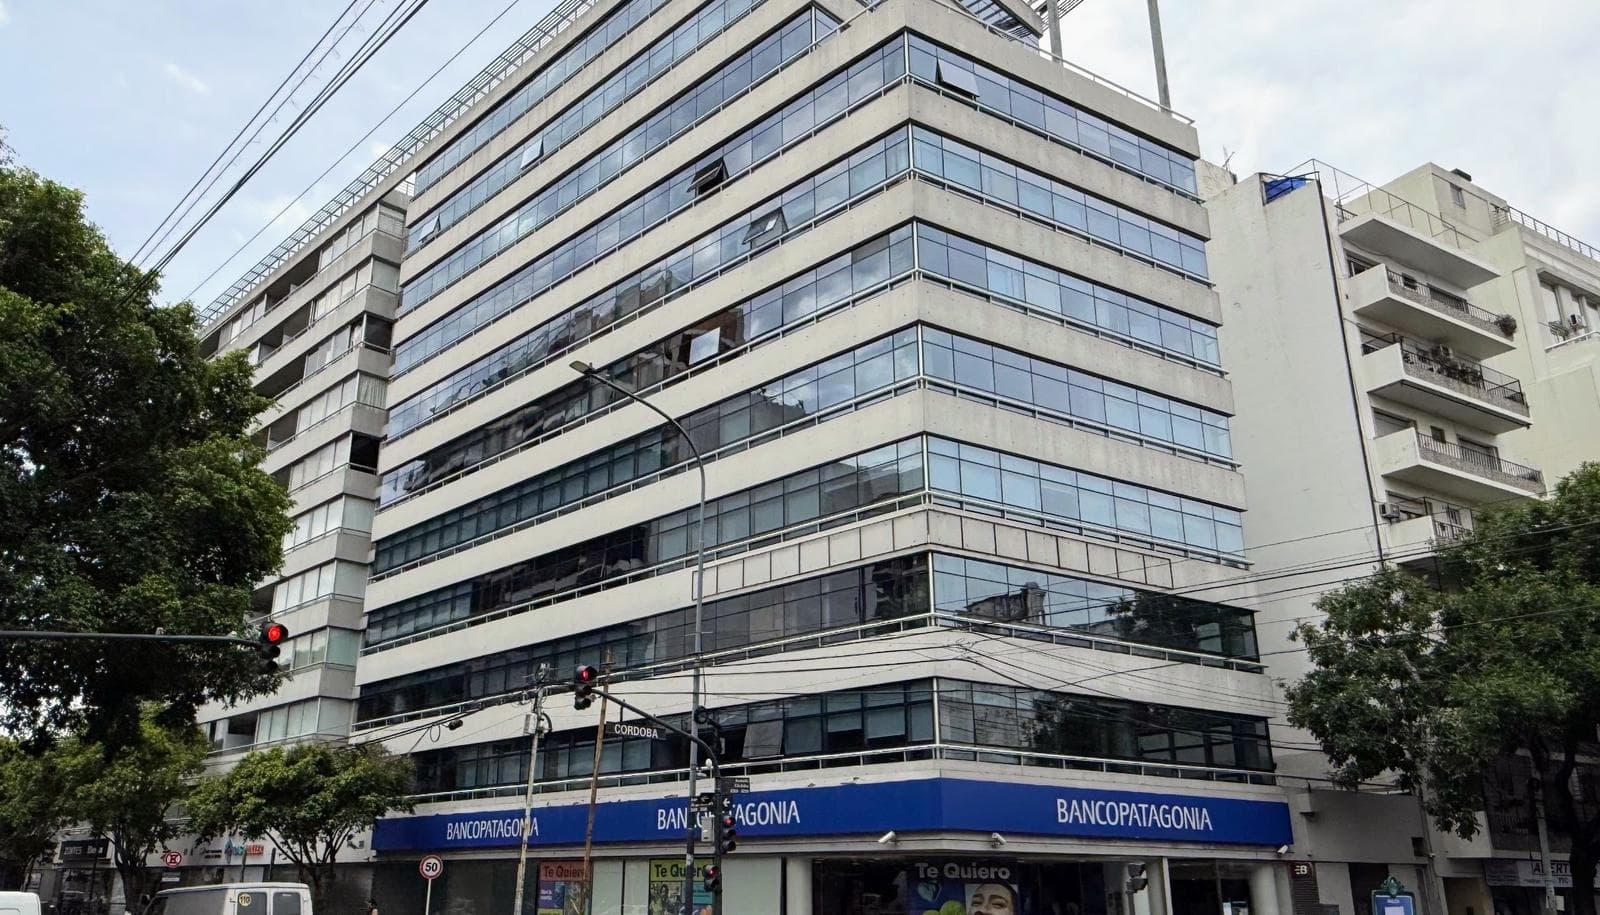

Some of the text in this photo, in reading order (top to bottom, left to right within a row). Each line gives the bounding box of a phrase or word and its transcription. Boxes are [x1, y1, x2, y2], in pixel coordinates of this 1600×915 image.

[614, 723, 658, 739] CORDOBA
[657, 800, 801, 830] BANAGONIA
[1056, 798, 1214, 831] BANCOPATAGONIA
[447, 817, 538, 840] BANCOPATAGONA
[425, 862, 438, 872] 50
[543, 865, 554, 878] Te
[654, 863, 706, 878] Te Qur
[915, 862, 1011, 880] Te Quiero
